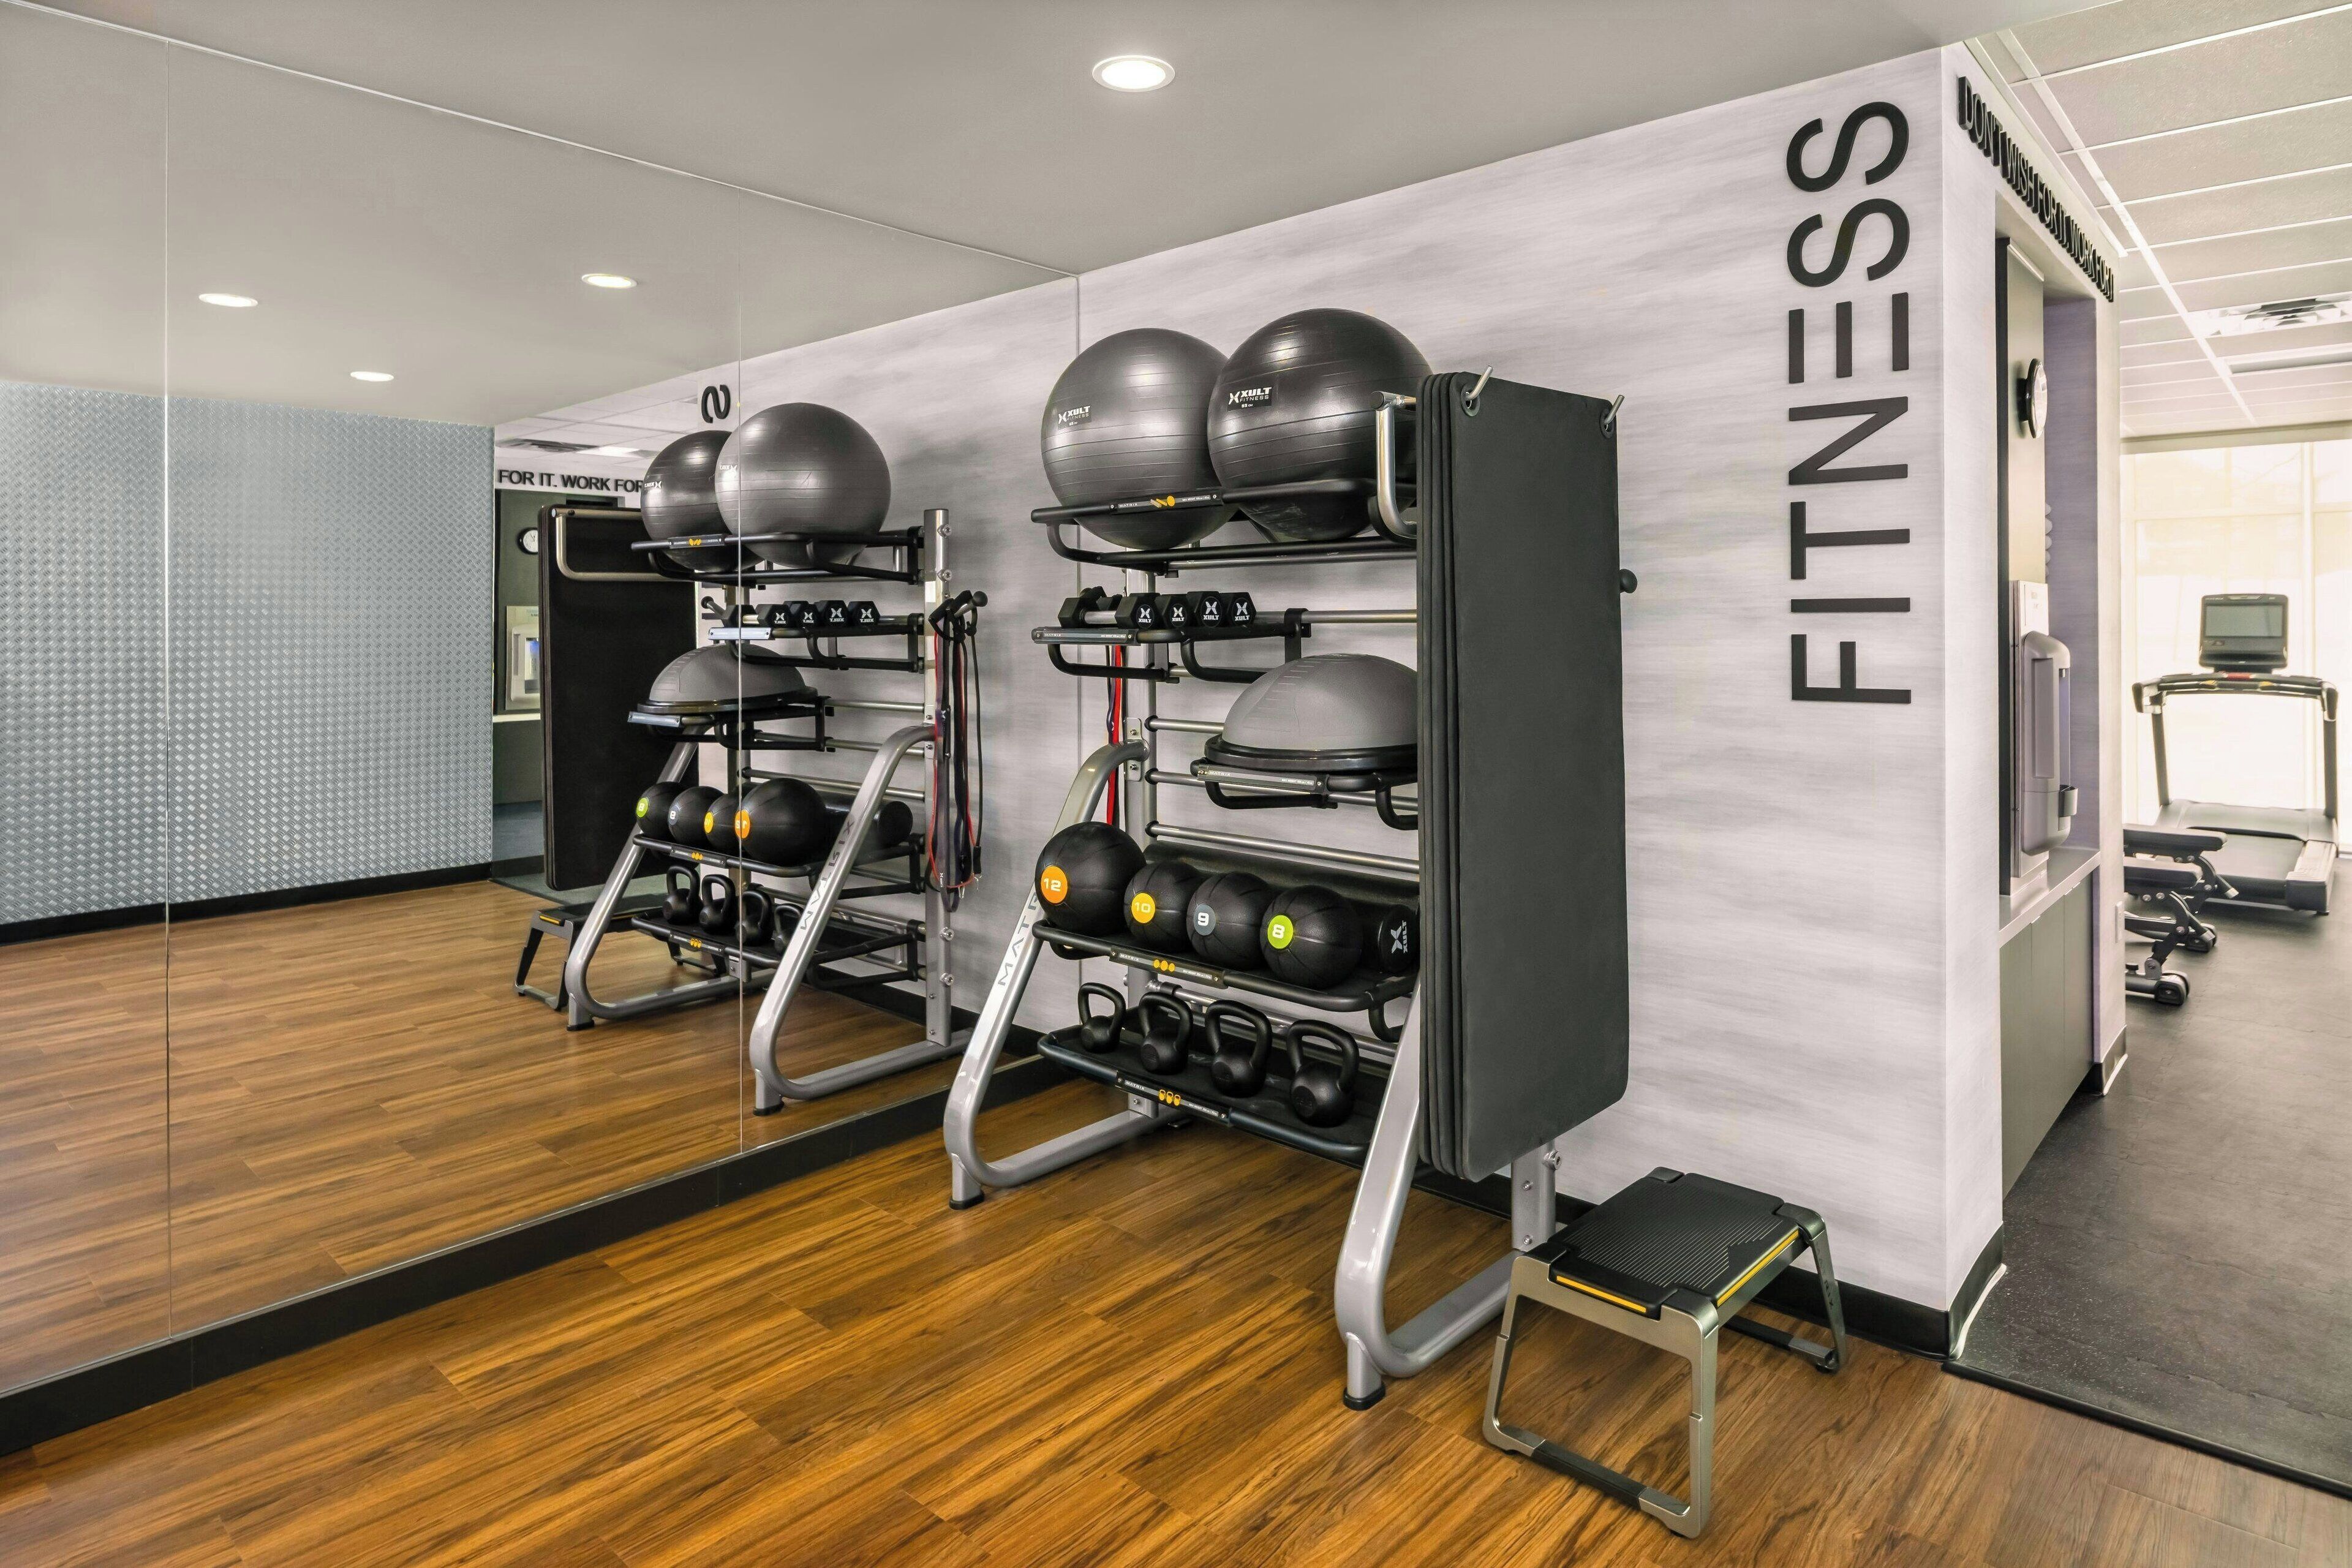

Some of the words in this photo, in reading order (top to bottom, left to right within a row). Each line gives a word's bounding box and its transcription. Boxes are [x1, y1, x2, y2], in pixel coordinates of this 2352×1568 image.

[1958, 76, 2003, 167] DON'T
[1240, 387, 1272, 398] XULT
[1786, 101, 1912, 704] FITNESS
[1067, 405, 1091, 417] XULT
[498, 469, 535, 486] FOR
[539, 472, 557, 488] IT.
[561, 474, 611, 491] WORK
[1043, 878, 1061, 892] 12
[1134, 902, 1152, 913] 10
[1197, 912, 1210, 927] 9
[1272, 924, 1285, 939] 8
[997, 892, 1039, 987] MATR
[1125, 1081, 1145, 1091] MATRIX
